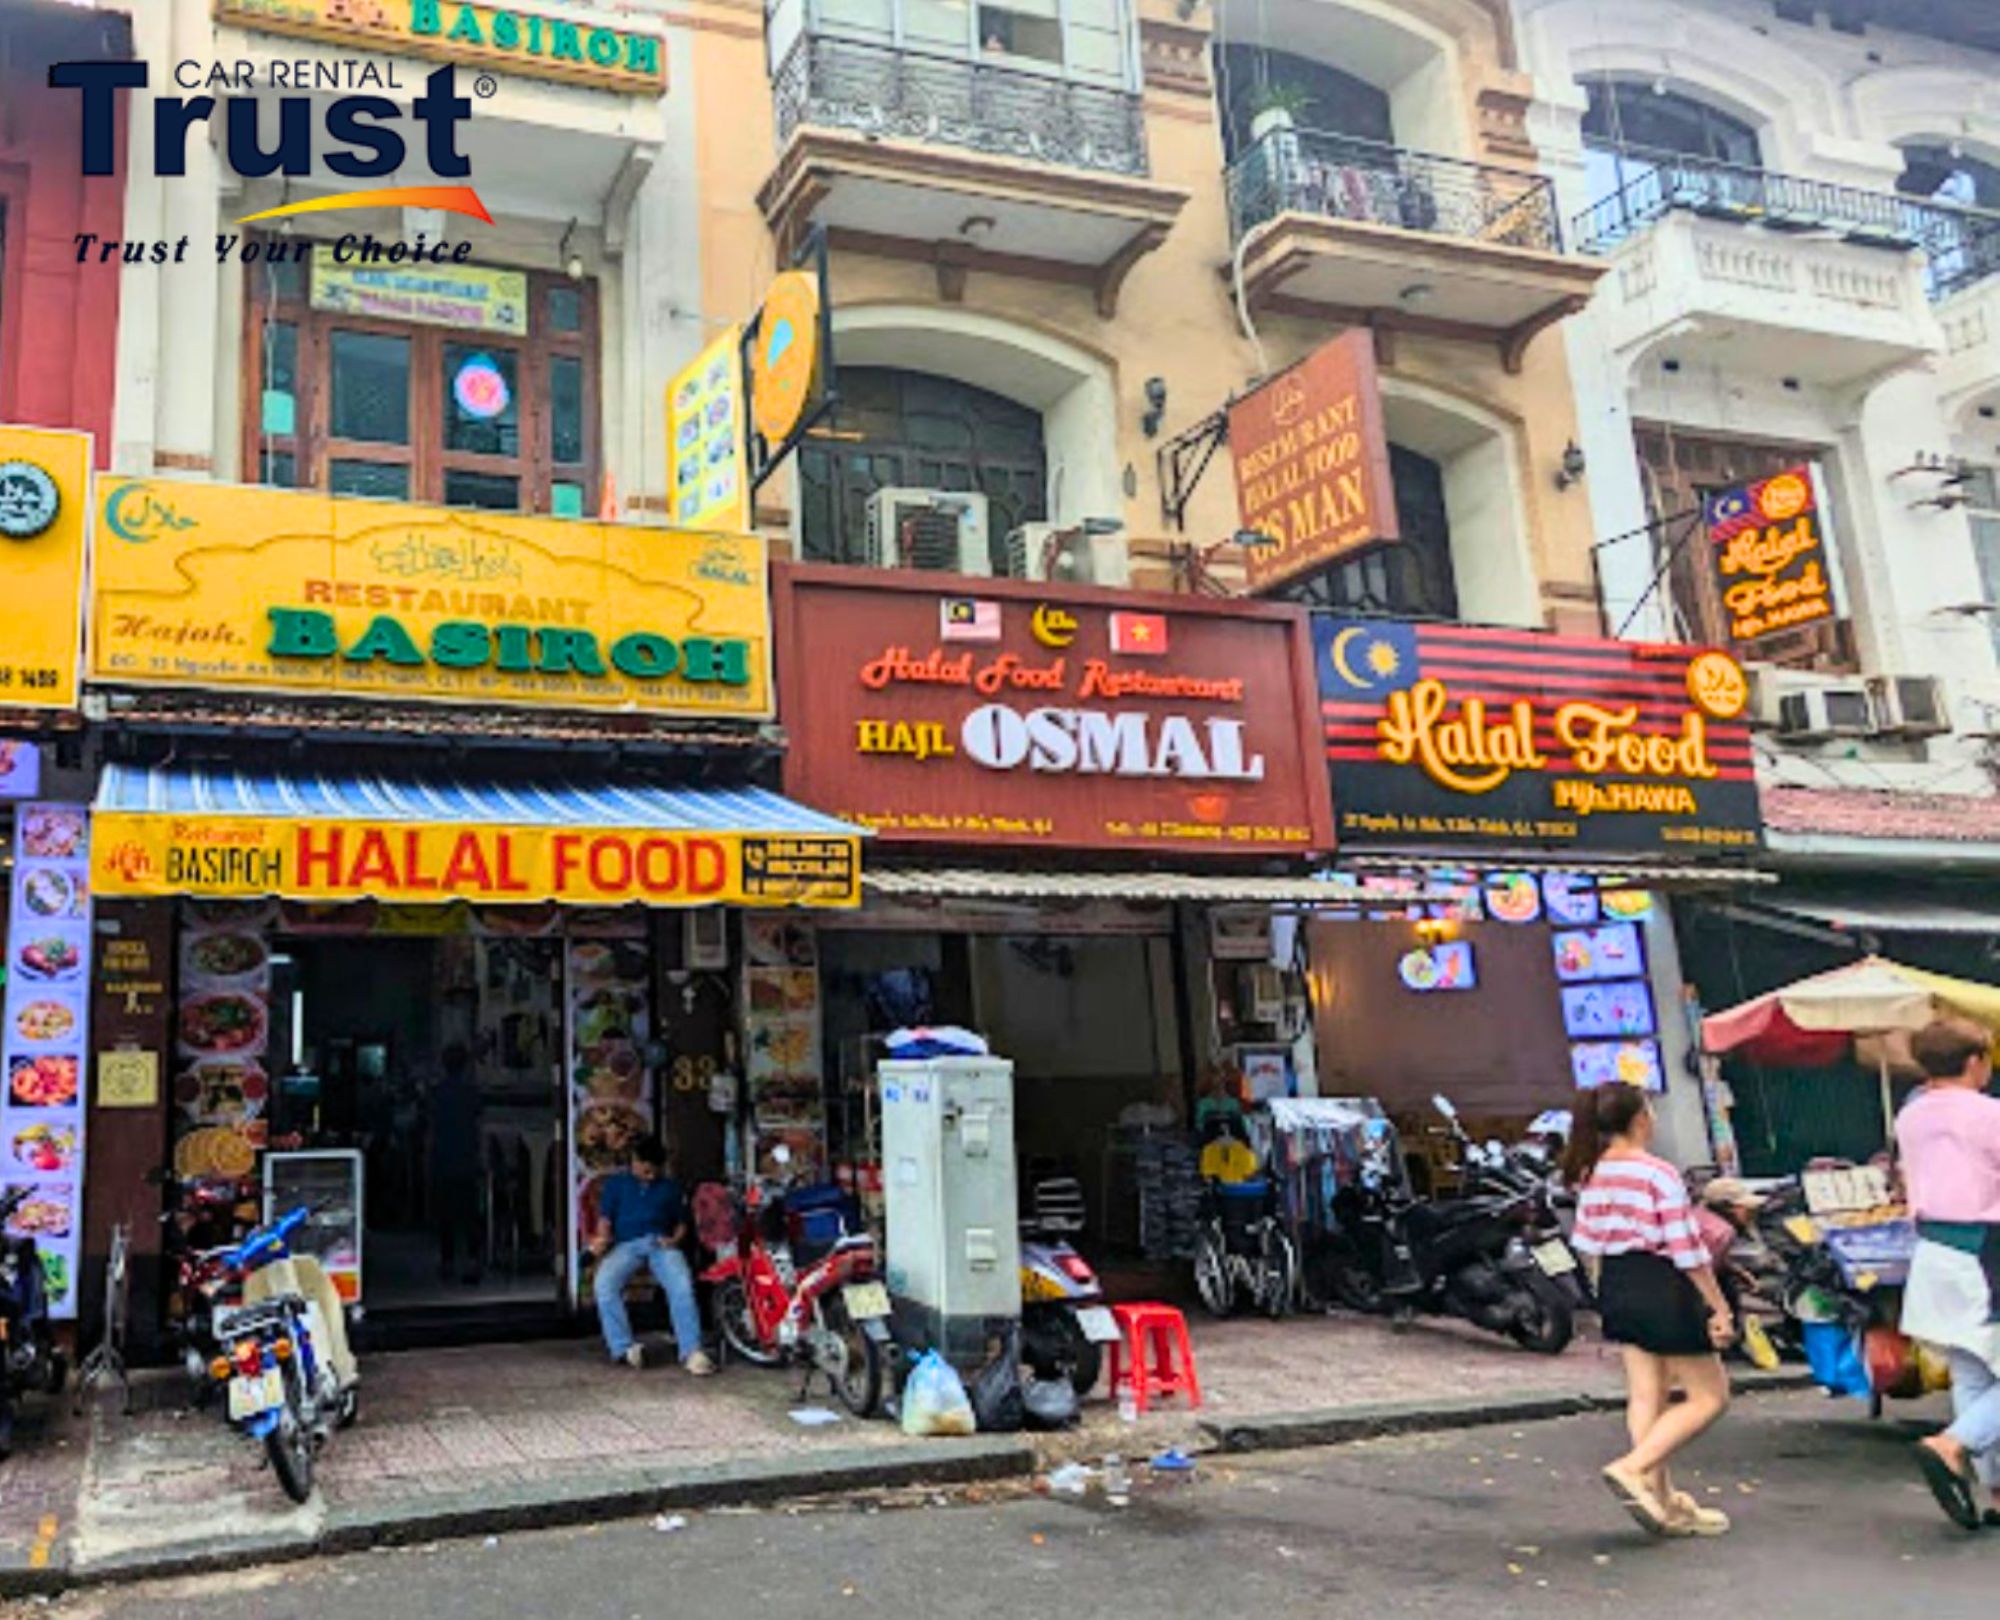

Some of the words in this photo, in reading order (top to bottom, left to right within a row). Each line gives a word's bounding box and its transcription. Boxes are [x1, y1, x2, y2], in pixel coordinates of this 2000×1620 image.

[1719, 516, 1819, 575] Halal
[303, 580, 593, 624] RESTAURANT
[266, 606, 749, 686] BASIROH
[859, 646, 973, 691] Halal
[973, 651, 1065, 694] Food
[1077, 656, 1243, 701] Restaurant
[1376, 677, 1548, 795] Halal
[1554, 700, 1718, 778] Food
[295, 826, 530, 892] HALAL
[550, 834, 728, 896] FOOD
